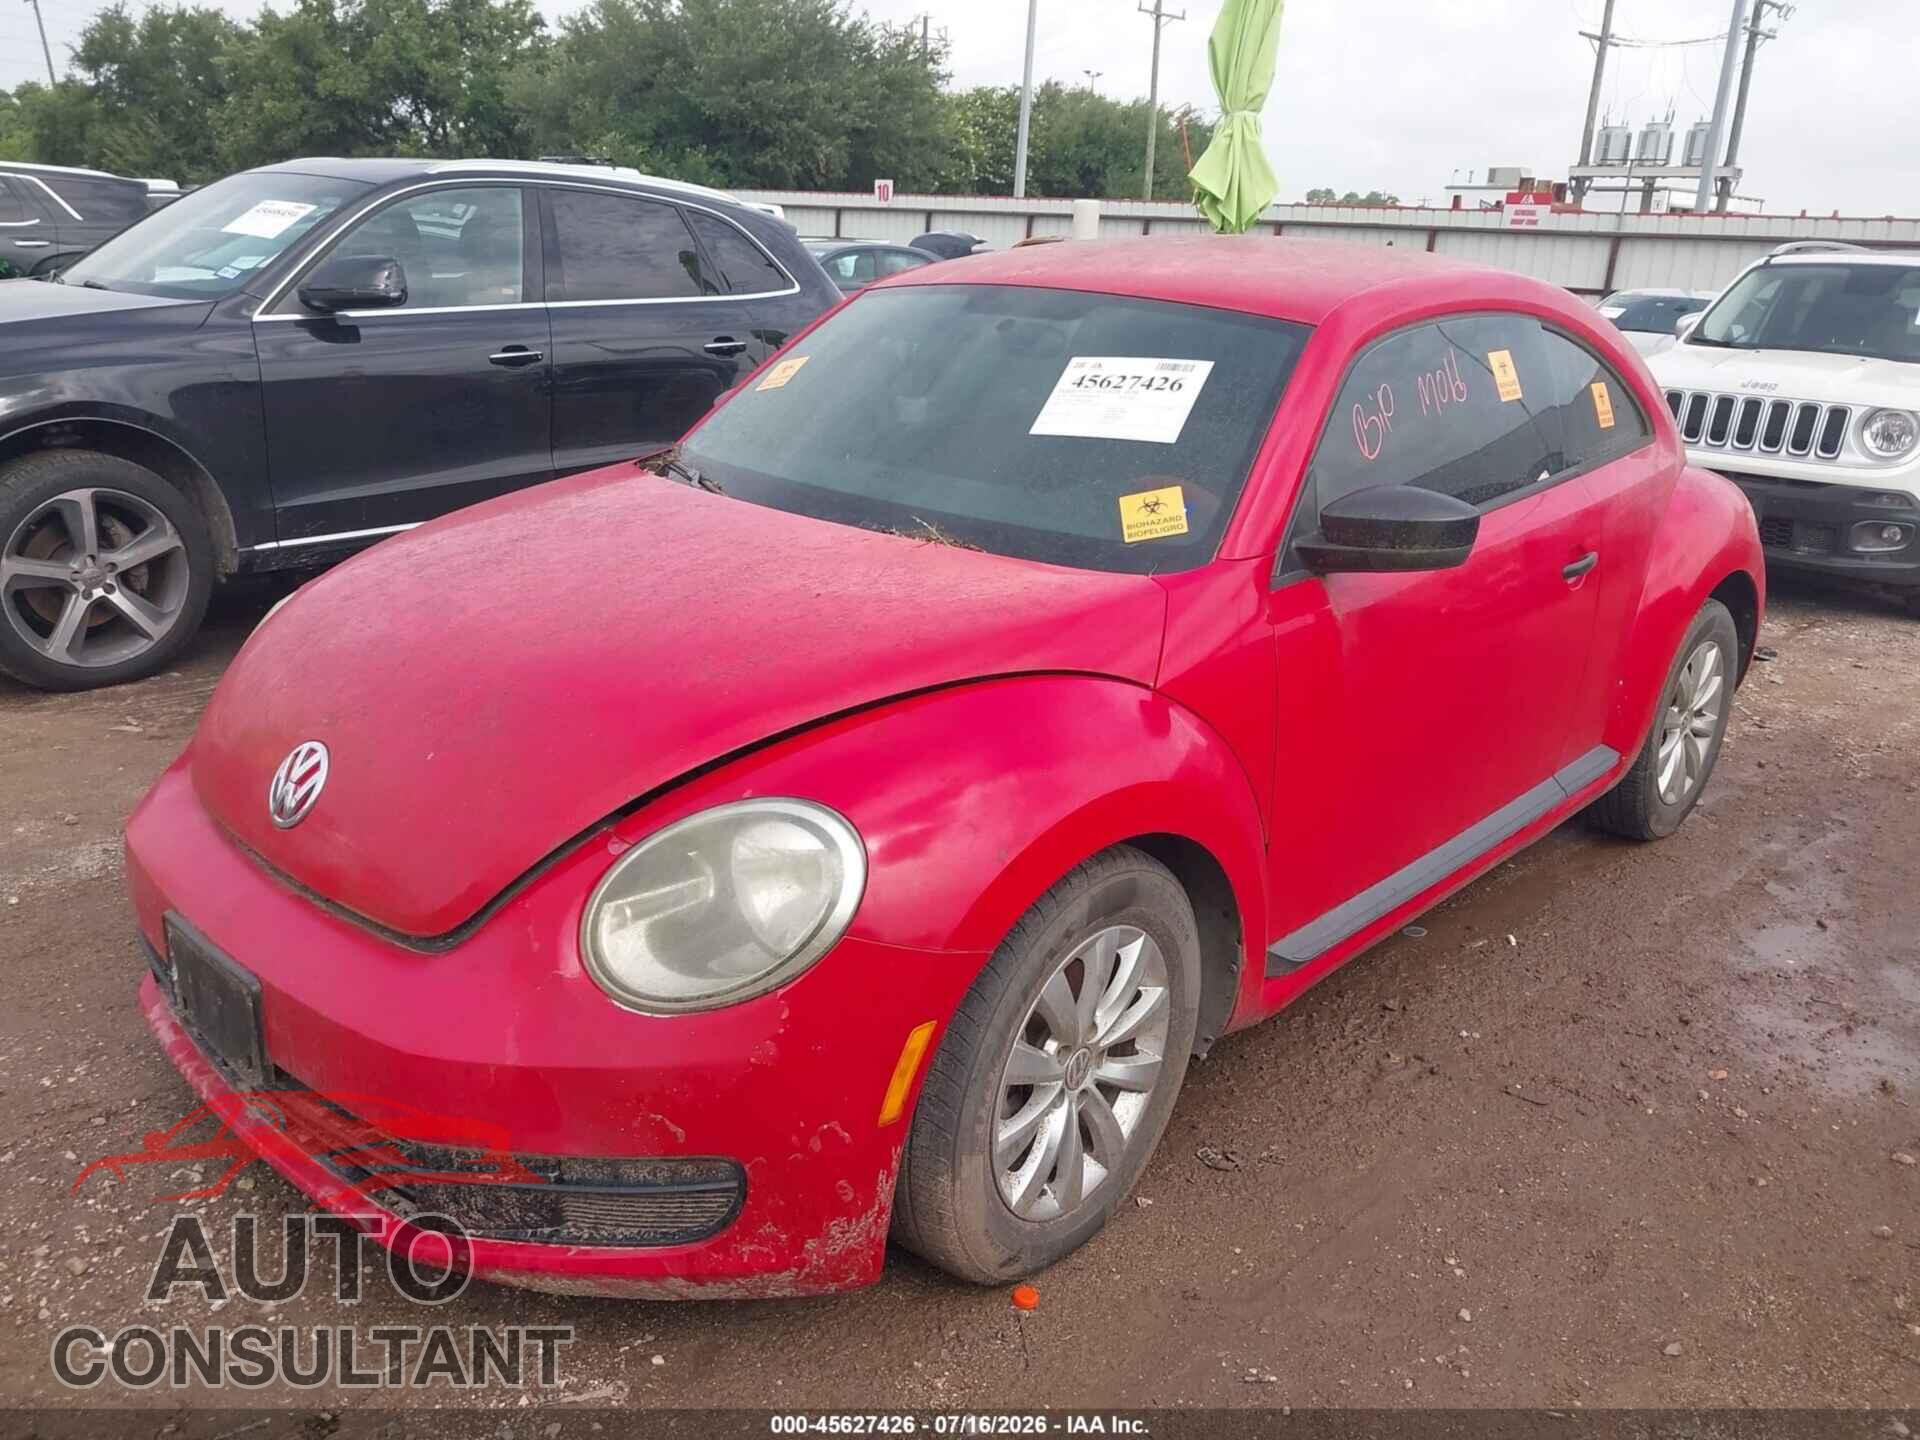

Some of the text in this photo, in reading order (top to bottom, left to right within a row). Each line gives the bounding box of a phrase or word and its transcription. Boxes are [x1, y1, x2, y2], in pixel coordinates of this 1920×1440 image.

[877, 183, 889, 202] 10
[1072, 374, 1185, 392] 45627426
[1127, 515, 1182, 530] BIOHAZARD
[1128, 523, 1184, 538] BIOPELIGRO
